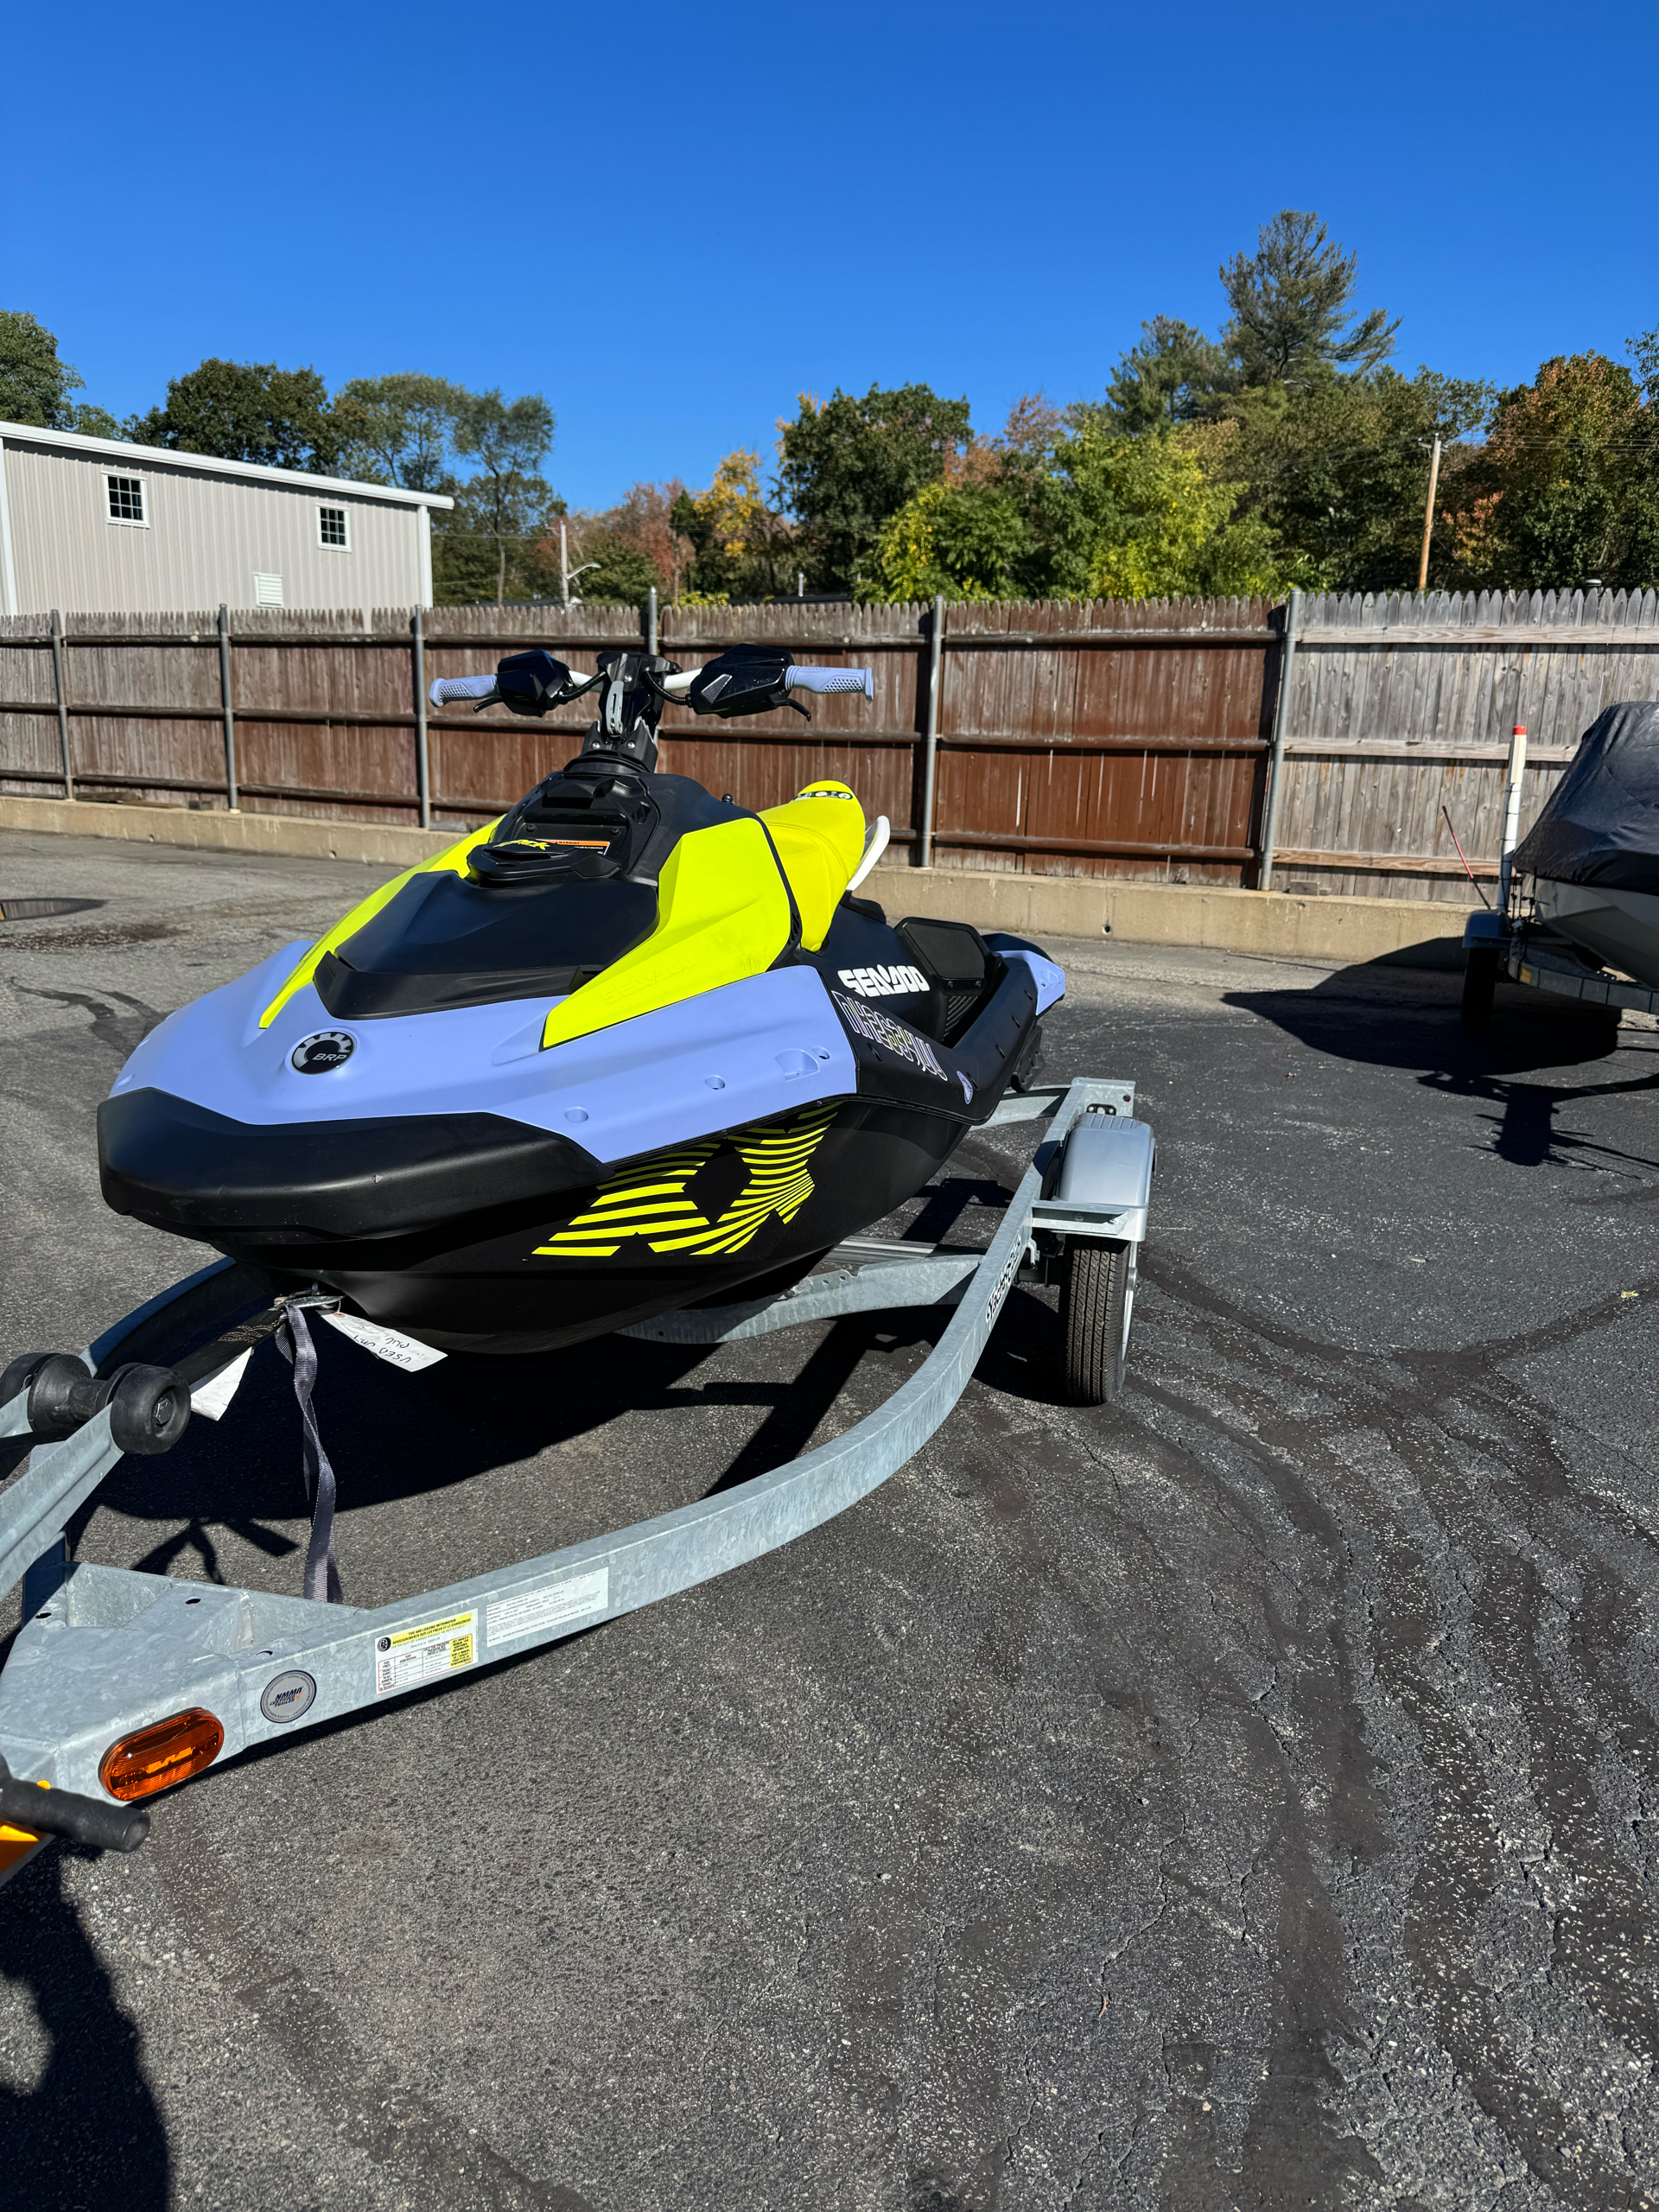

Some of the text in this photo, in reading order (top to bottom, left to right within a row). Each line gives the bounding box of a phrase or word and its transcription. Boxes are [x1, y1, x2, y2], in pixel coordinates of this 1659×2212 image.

[312, 1053, 347, 1062] BRP
[379, 1347, 411, 1363] USED
[436, 1619, 455, 1628] INFORMATION
[275, 1687, 302, 1700] NMMA
